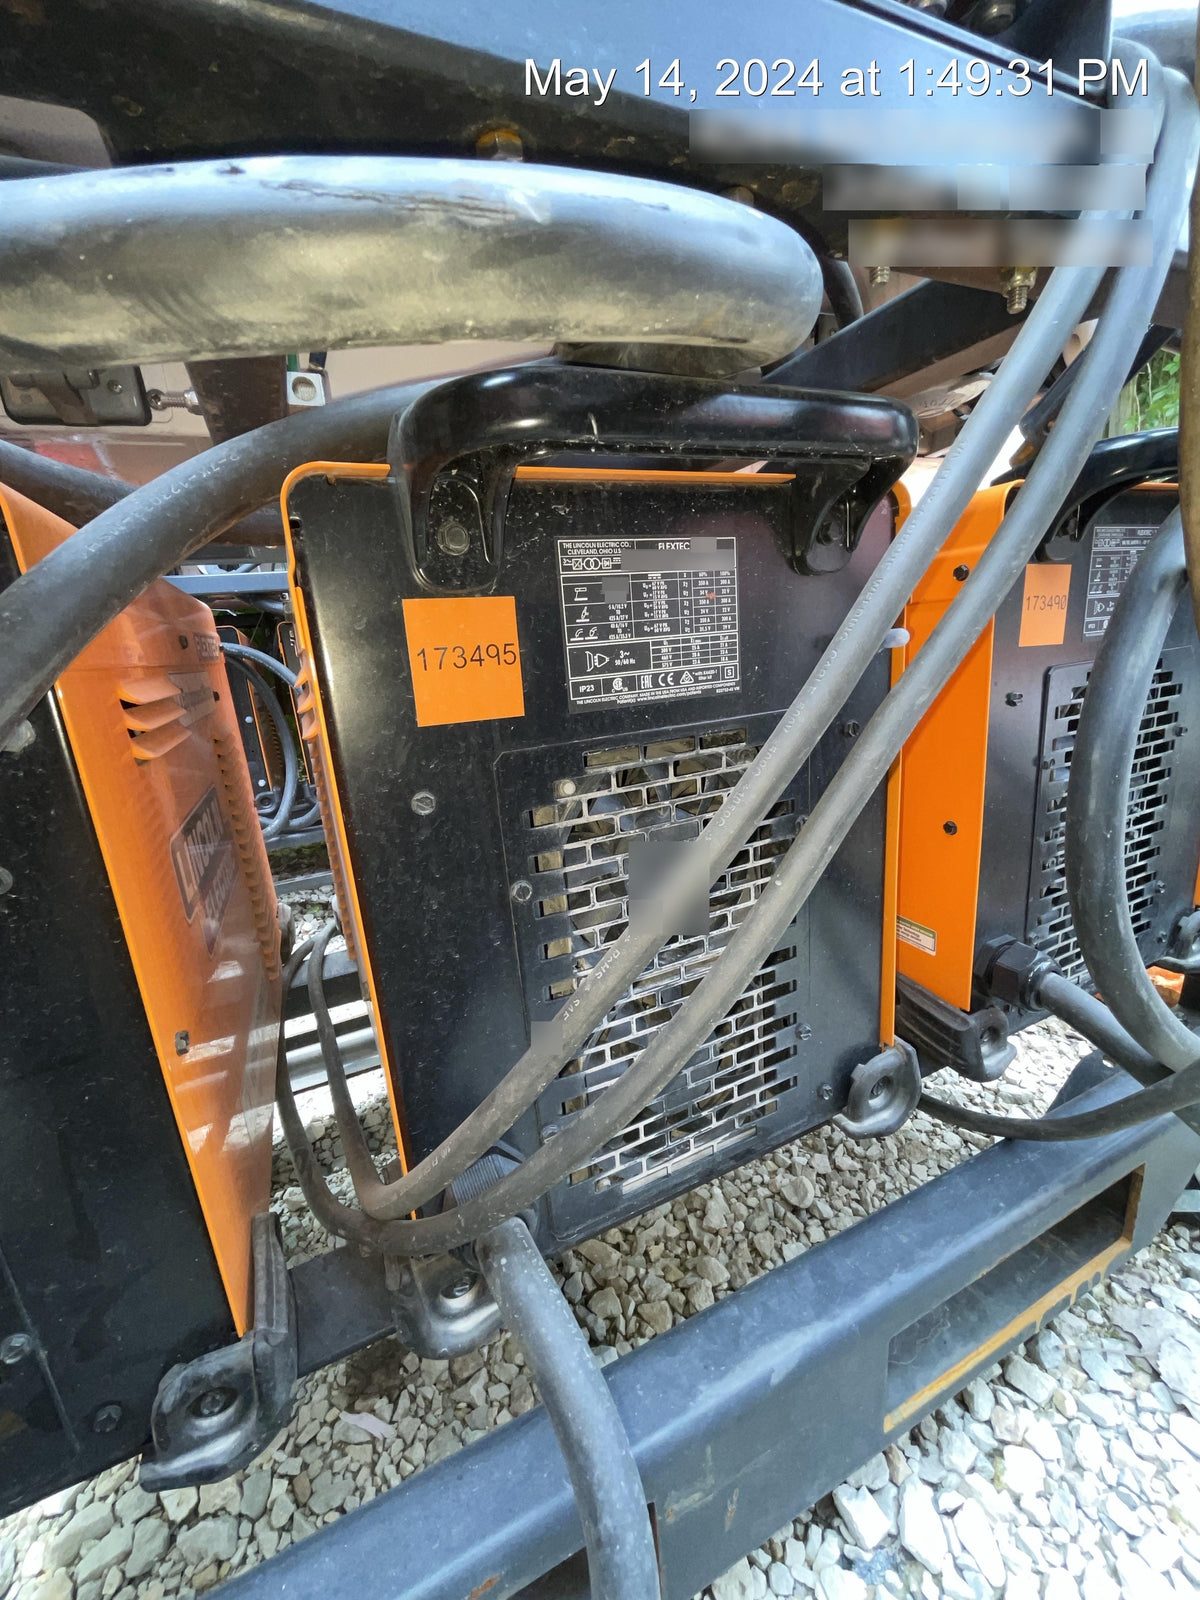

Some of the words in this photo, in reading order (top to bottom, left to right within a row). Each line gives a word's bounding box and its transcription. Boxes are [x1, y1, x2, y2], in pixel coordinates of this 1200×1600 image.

[1026, 594, 1068, 612] 173490
[417, 643, 517, 671] 173495
[579, 685, 595, 693] IP23
[658, 672, 675, 687] CE
[177, 797, 224, 905] LINCOLN
[592, 947, 621, 980] RoHS
